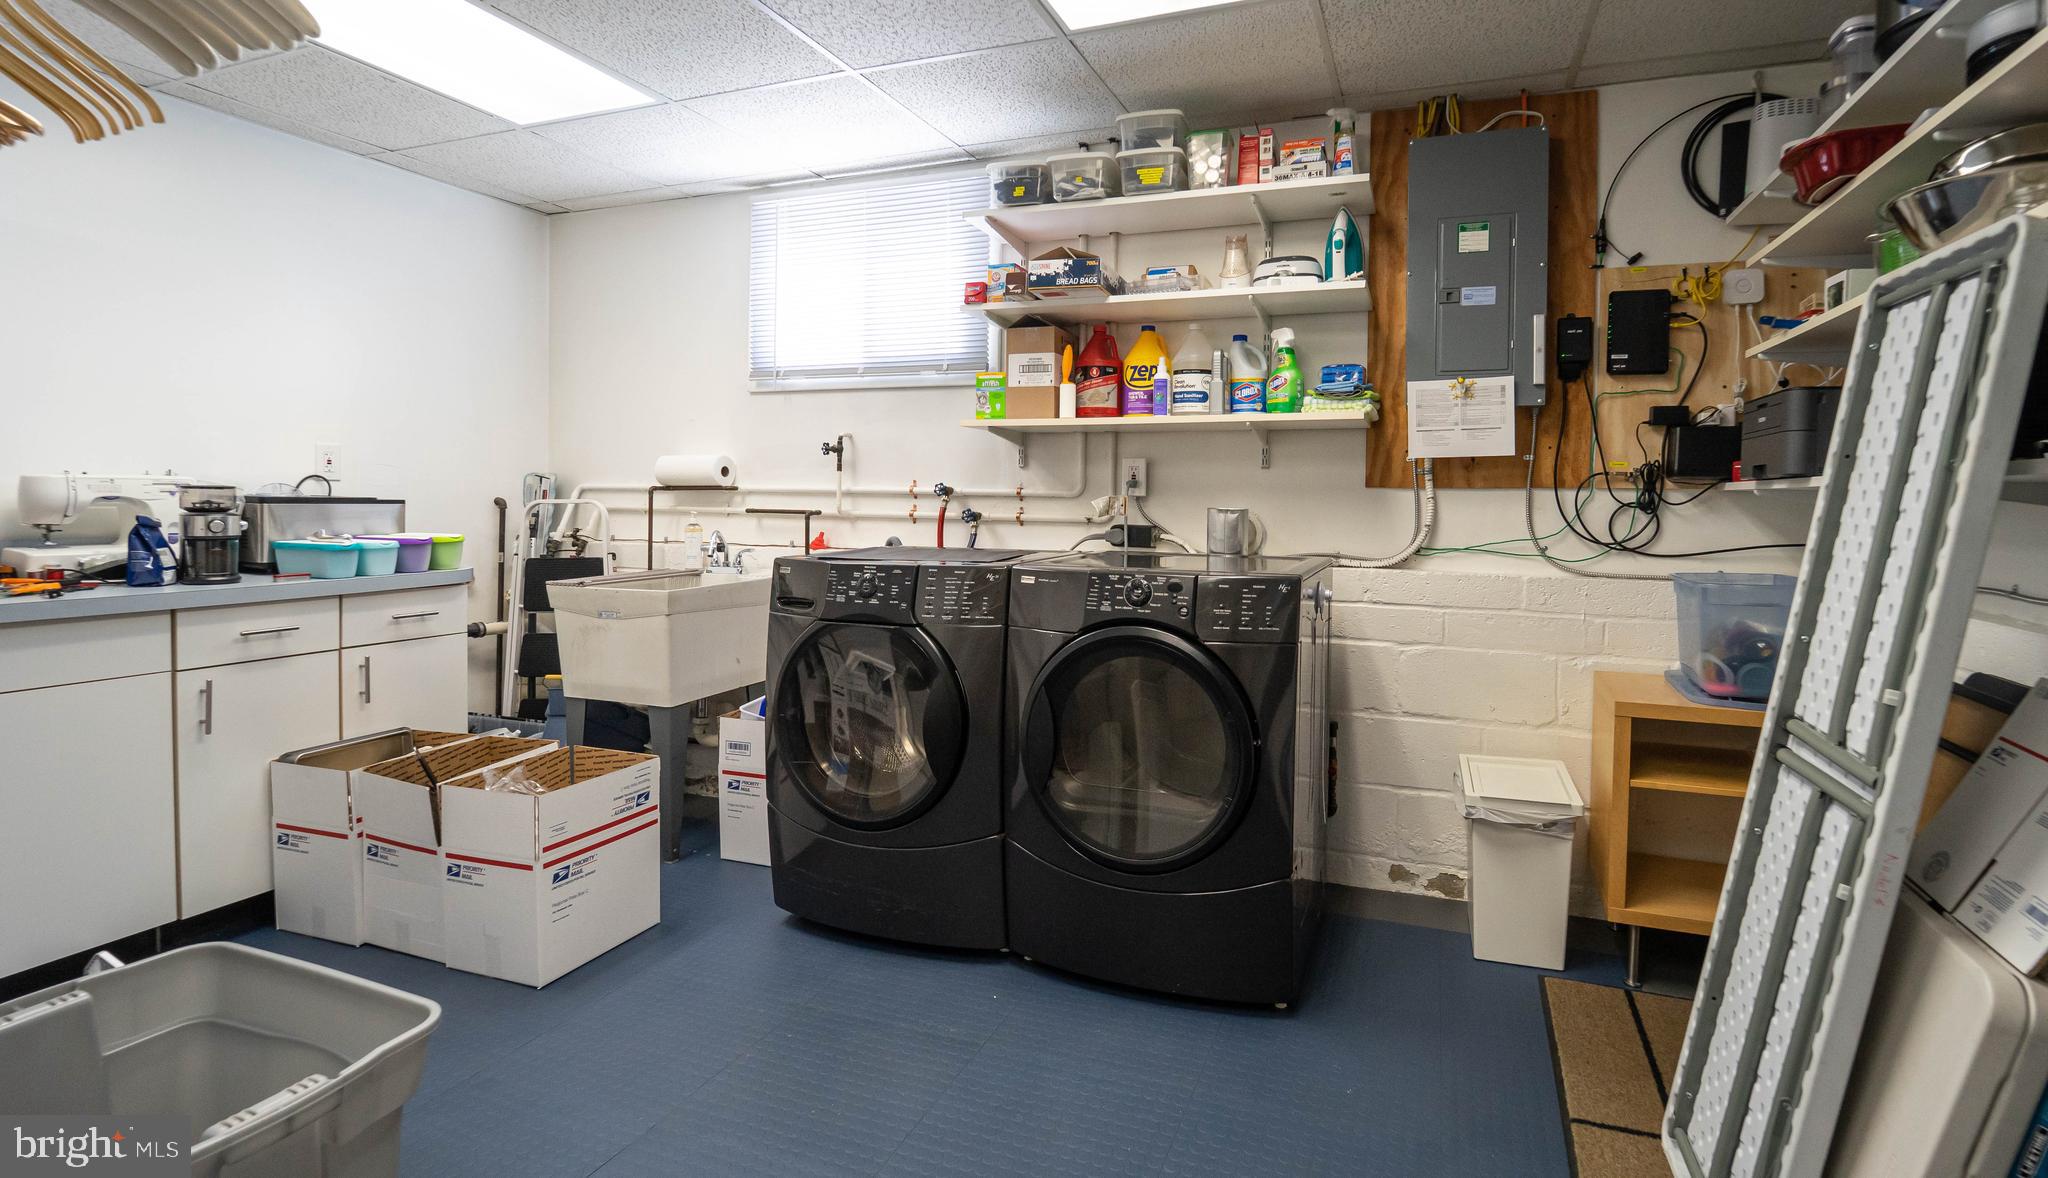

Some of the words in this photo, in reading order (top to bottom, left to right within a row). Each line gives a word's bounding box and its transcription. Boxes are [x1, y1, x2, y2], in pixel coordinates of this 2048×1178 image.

[1056, 277, 1078, 285] BREAD
[1079, 276, 1098, 284] BAGS
[1234, 386, 1259, 399] CLOROX
[571, 854, 596, 868] PRIORITY
